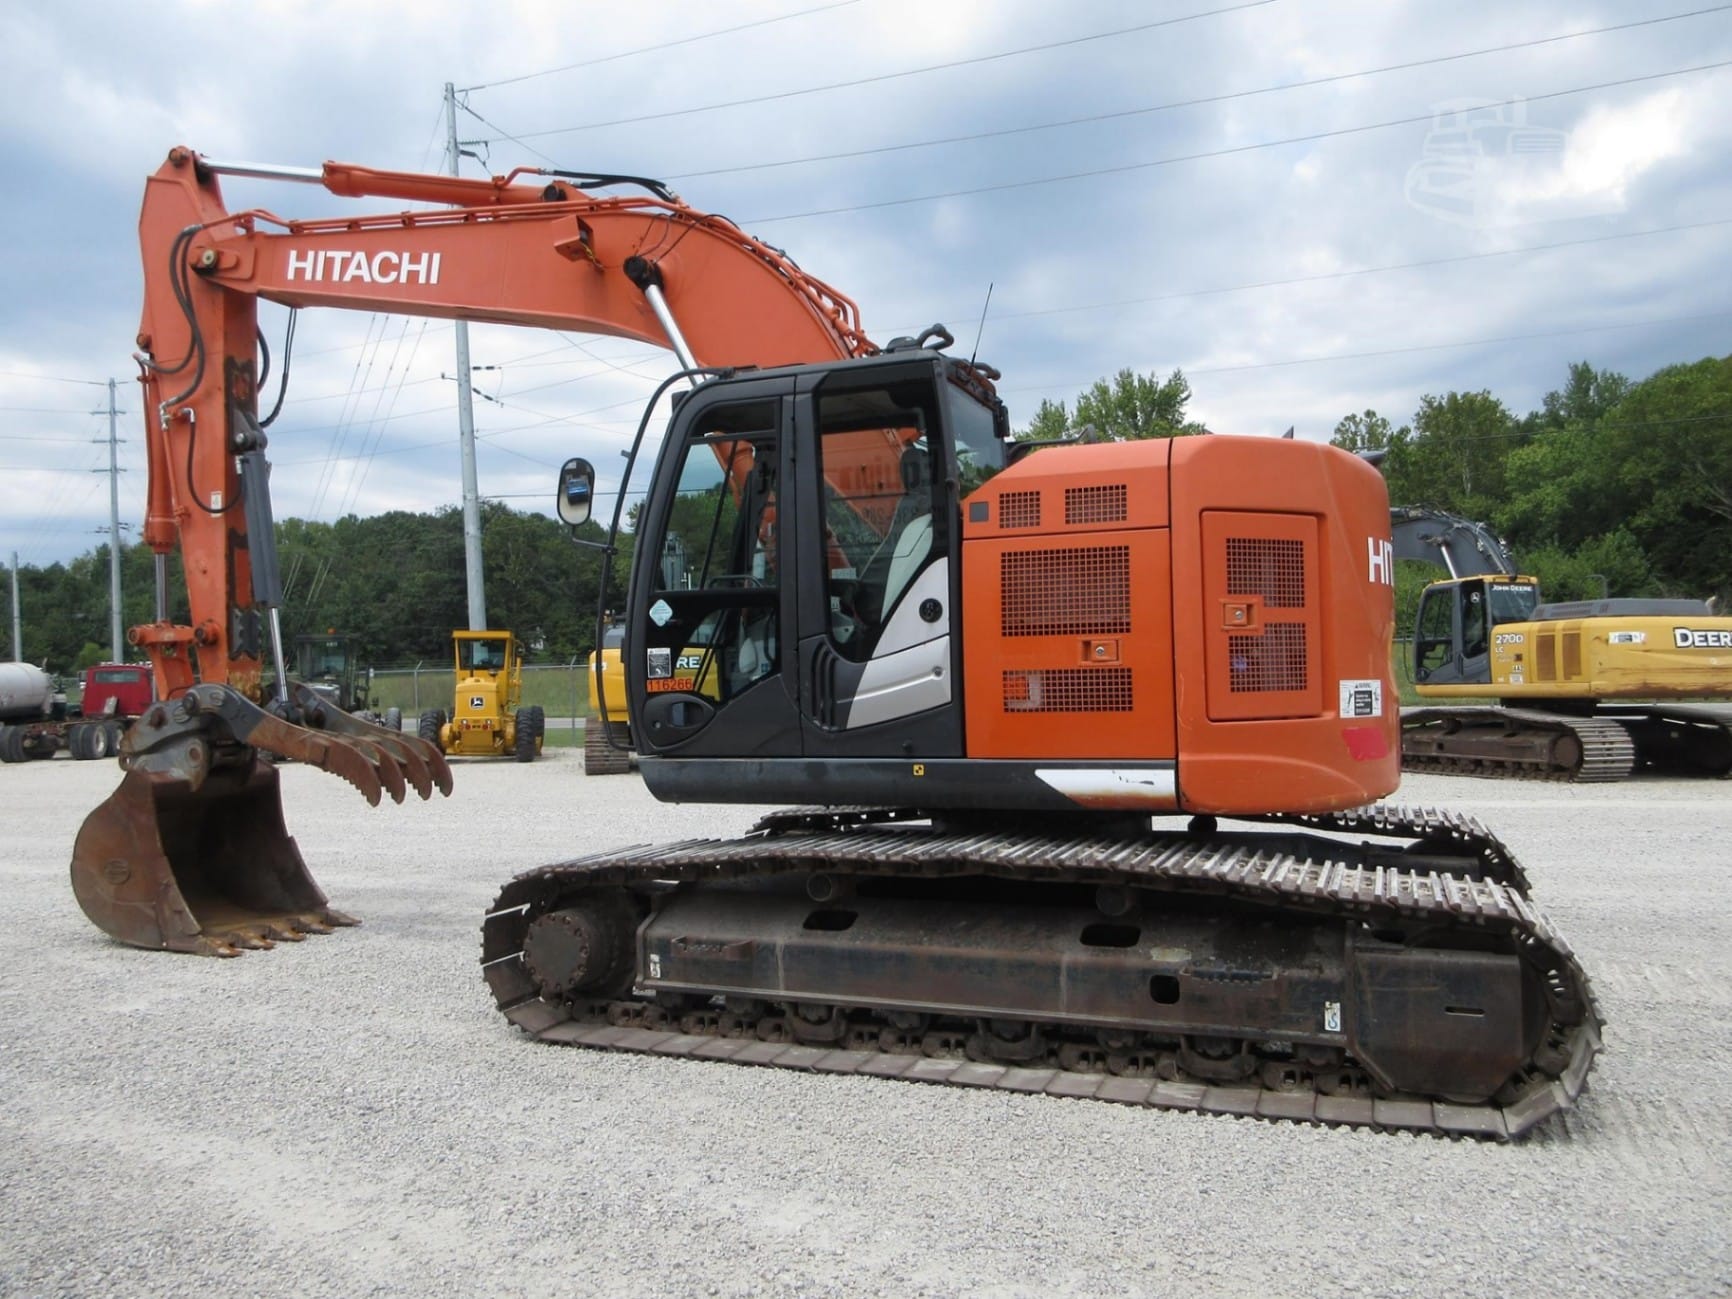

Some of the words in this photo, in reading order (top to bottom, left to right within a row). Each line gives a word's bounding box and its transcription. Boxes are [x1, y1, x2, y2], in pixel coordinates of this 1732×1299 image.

[287, 250, 441, 285] HITACHI
[1491, 584, 1509, 592] JOHN
[1510, 584, 1533, 592] DEERE
[1495, 633, 1524, 645] 270D
[1673, 627, 1732, 648] DEER
[676, 656, 701, 669] RE
[647, 678, 693, 691] 116266
